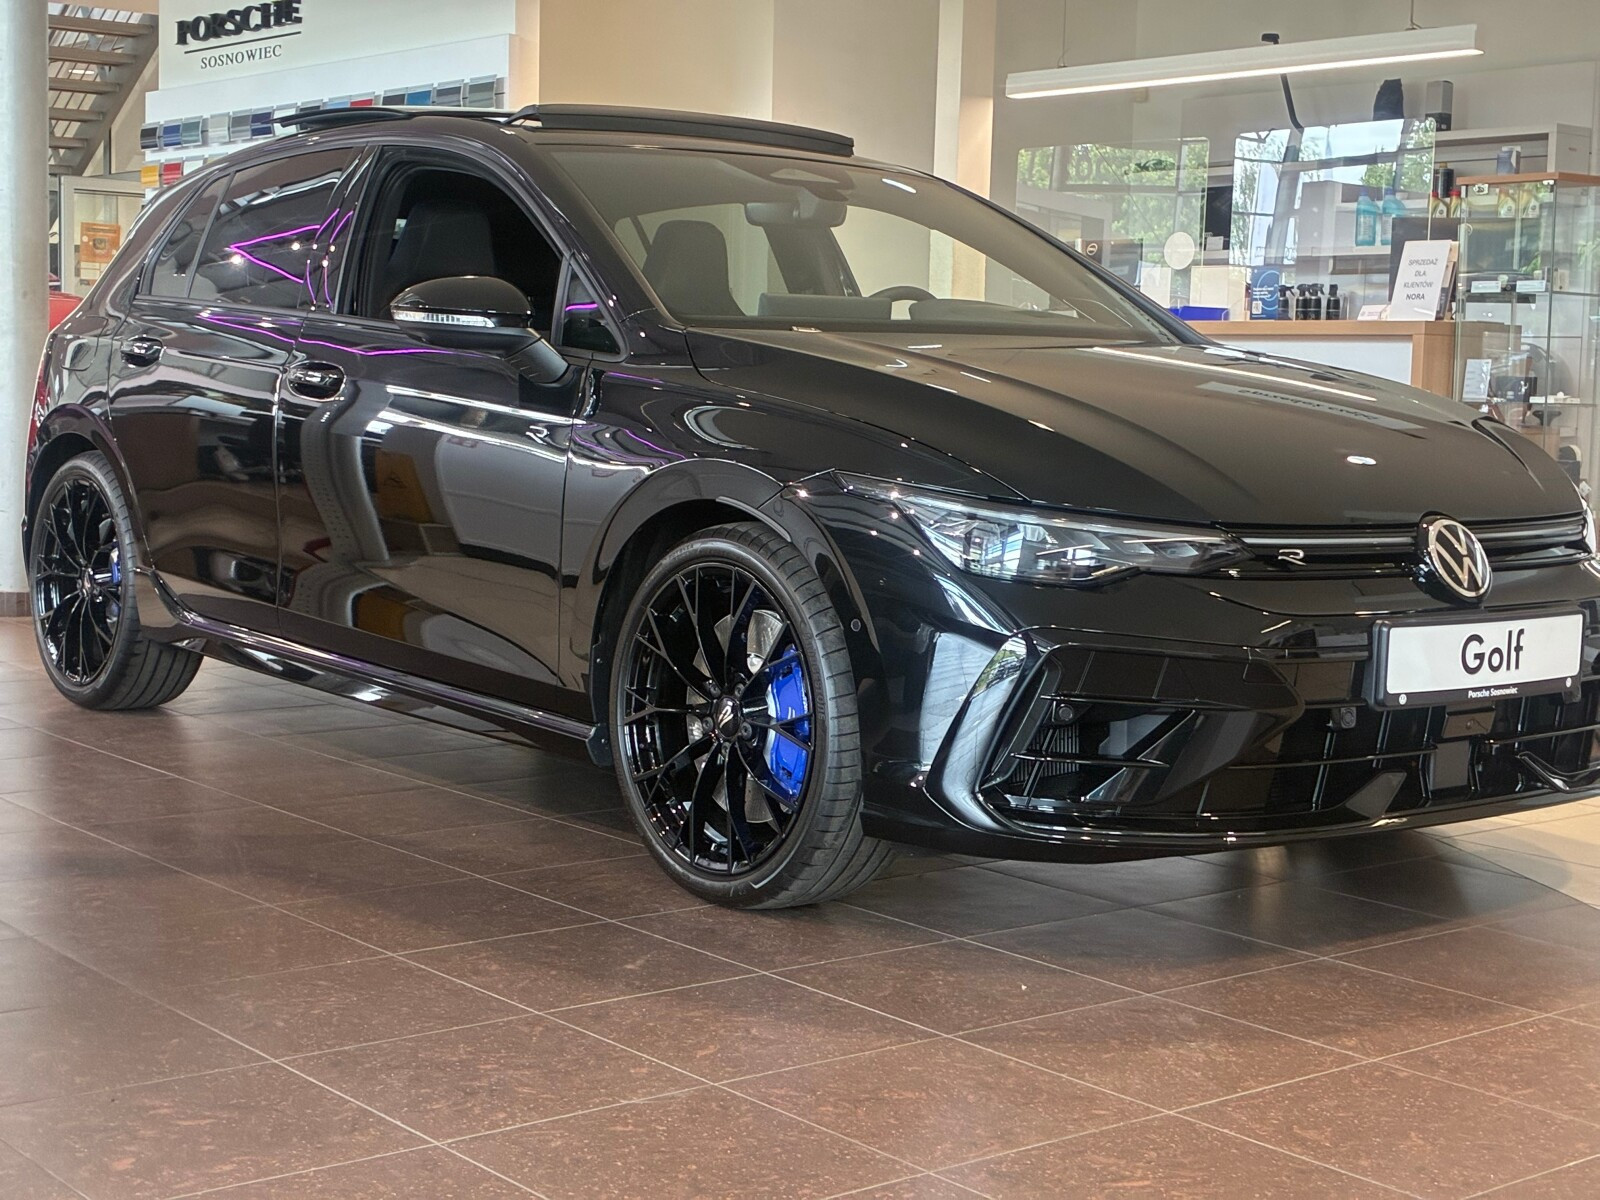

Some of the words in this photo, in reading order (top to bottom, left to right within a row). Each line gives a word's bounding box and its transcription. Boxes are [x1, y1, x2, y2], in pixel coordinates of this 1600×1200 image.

[175, 0, 303, 45] PORSCHE
[200, 45, 282, 69] SOSNOWIEC
[1403, 281, 1434, 289] KLIENTÓW
[1405, 293, 1425, 301] NORA
[1278, 549, 1307, 566] R
[1461, 628, 1525, 675] Golf
[1468, 689, 1489, 698] Porsche
[1490, 686, 1518, 696] Sosnowiec
